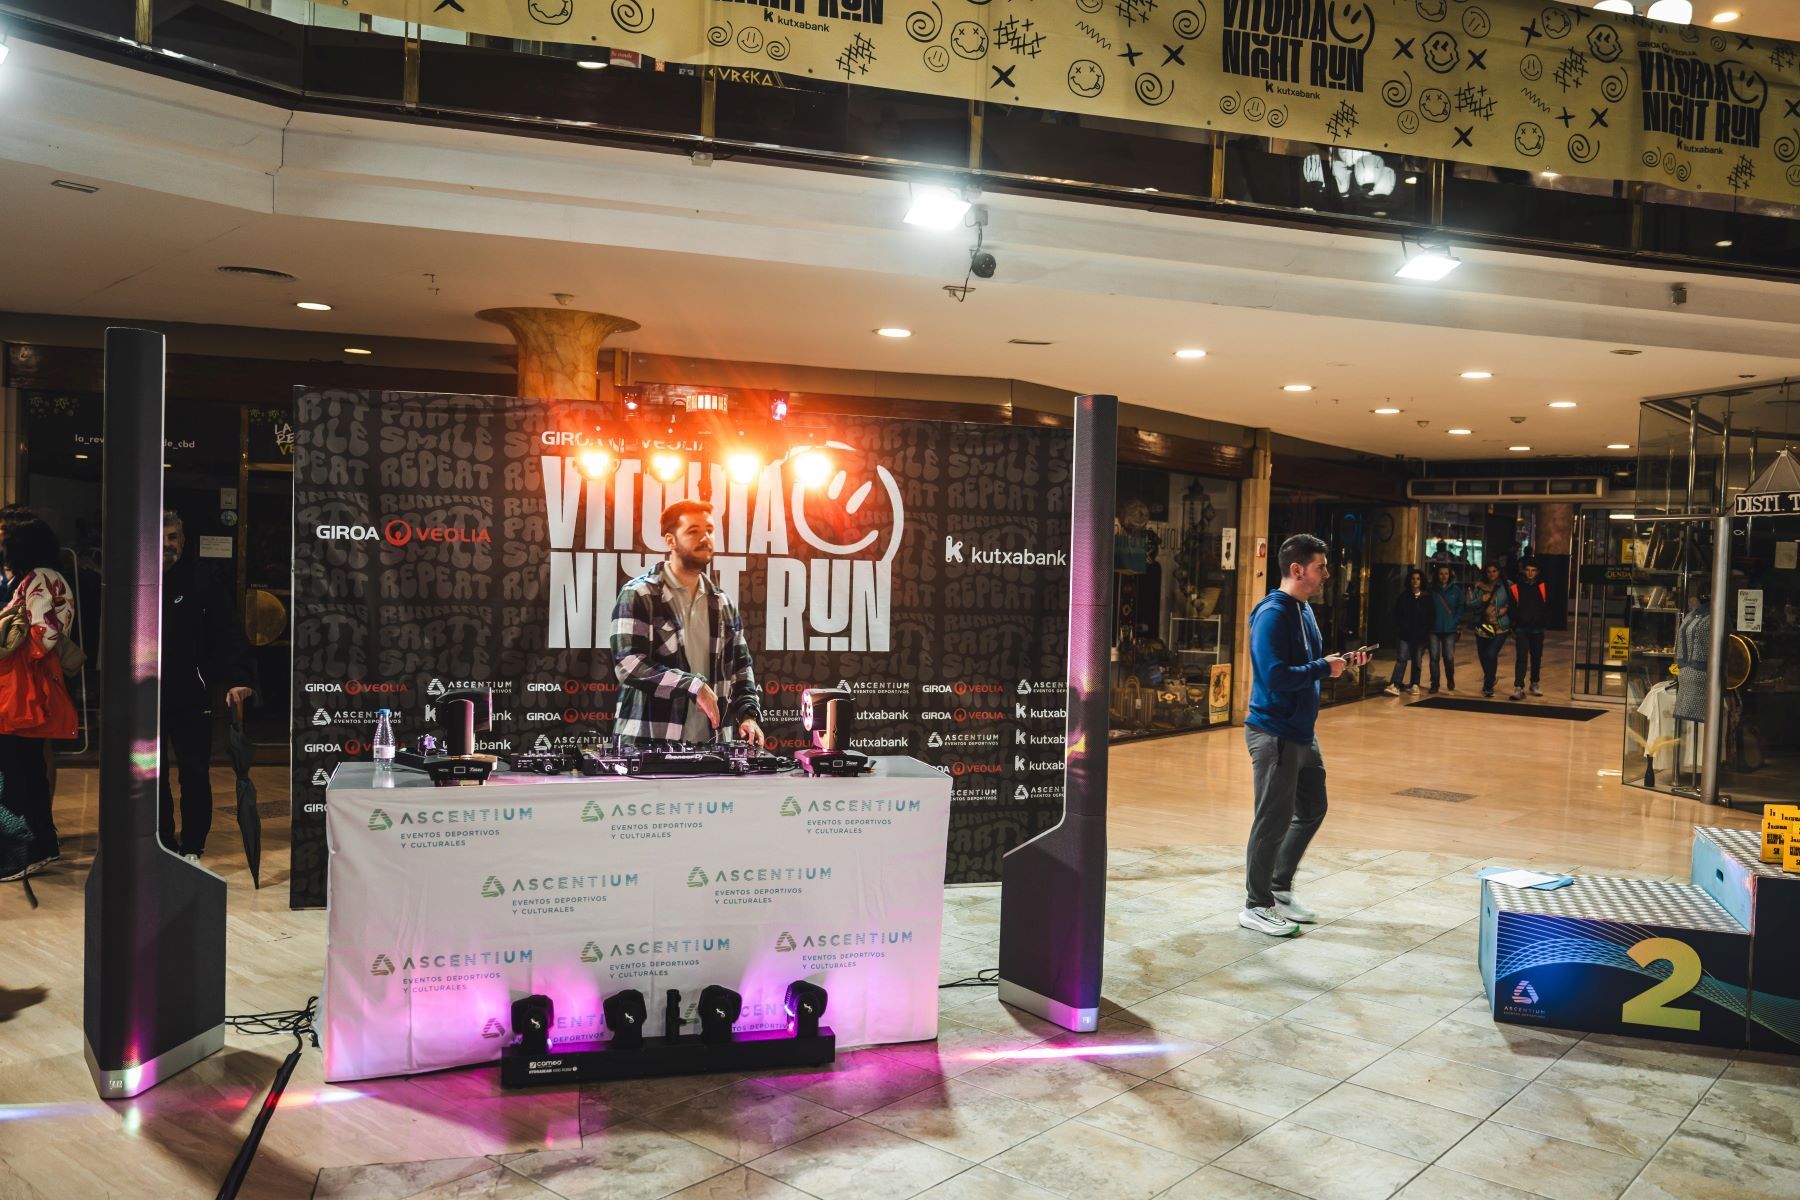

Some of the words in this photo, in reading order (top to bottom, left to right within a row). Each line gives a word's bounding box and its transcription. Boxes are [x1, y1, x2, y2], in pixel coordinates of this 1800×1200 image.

[777, 16, 830, 33] kutxabank
[1223, 29, 1304, 84] NIGHT
[1310, 42, 1365, 93] RUN
[1638, 50, 1730, 102] VITORIA
[1277, 86, 1321, 100] kutxabank
[1642, 91, 1710, 141] NIGHT
[1714, 102, 1761, 149] RUN
[380, 423, 493, 461] SMILE
[380, 450, 494, 490] REPEAT
[949, 451, 1040, 486] SMILE
[947, 476, 1039, 511] REPEAT
[380, 495, 494, 515] RUNNING
[947, 514, 1039, 535] RUNNING
[315, 525, 380, 541] GIROA
[416, 527, 492, 543] VEOLIA
[971, 547, 1067, 566] kutxabank
[379, 561, 493, 600] REPEAT
[944, 575, 1035, 610] REPEAT
[765, 556, 892, 653] RUN
[379, 604, 492, 625] RUNNING
[379, 615, 492, 650] PARTY
[379, 643, 491, 680] SMILE
[839, 649, 935, 681] SMILE
[942, 651, 1032, 680] SMILE
[304, 683, 342, 692] GIROA
[364, 683, 409, 693] VEOLIA
[527, 683, 562, 692] GIROA
[853, 682, 910, 690] ASCENTIUM
[922, 684, 952, 693] GIROA
[968, 684, 1003, 693] VEOLIA
[526, 712, 561, 721] GIROA
[856, 710, 909, 720] utxabank
[921, 711, 952, 720] GIROA
[968, 711, 1004, 720] VEOLIA
[304, 743, 342, 753] GIROA
[850, 737, 908, 747] kutxabank
[967, 764, 1003, 772] VEOLIA
[611, 801, 734, 817] ASCENTIUM
[807, 799, 921, 812] ASCENTIUM
[401, 807, 533, 825] ASCENTIUM
[844, 818, 892, 826] DEPORTIVOS
[611, 823, 649, 831] EVENTOS
[652, 822, 703, 830] DEPORTIVOS
[400, 831, 441, 840] EVENTOS
[445, 829, 500, 838] DEPORTIVOS
[620, 832, 672, 840] CULTURALES
[410, 839, 466, 849] CULTURALES
[714, 867, 832, 882] ASCENTIUM
[512, 873, 639, 892] ASCENTIUM
[714, 889, 751, 897] EVENTOS
[754, 887, 803, 896] DEPORTIVOS
[512, 899, 551, 907] EVENTOS
[554, 895, 607, 904] DEPORTIVOS
[723, 897, 772, 905] CULTURALES
[521, 906, 575, 915] CULTURALES
[802, 930, 914, 948] ASCENTIUM
[609, 937, 731, 957] ASCENTIUM
[403, 949, 534, 971] ASCENTIUM
[802, 954, 837, 962] EVENTOS
[840, 951, 886, 960] DEPORTIVOS
[609, 962, 646, 971] EVENTOS
[649, 959, 700, 967] DEPORTIVOS
[809, 961, 857, 969] CULTURALES
[402, 974, 443, 985] EVENTOS
[446, 972, 501, 983] DEPORTIVOS
[618, 970, 669, 979] CULTURALES
[1621, 937, 1702, 1031] 2
